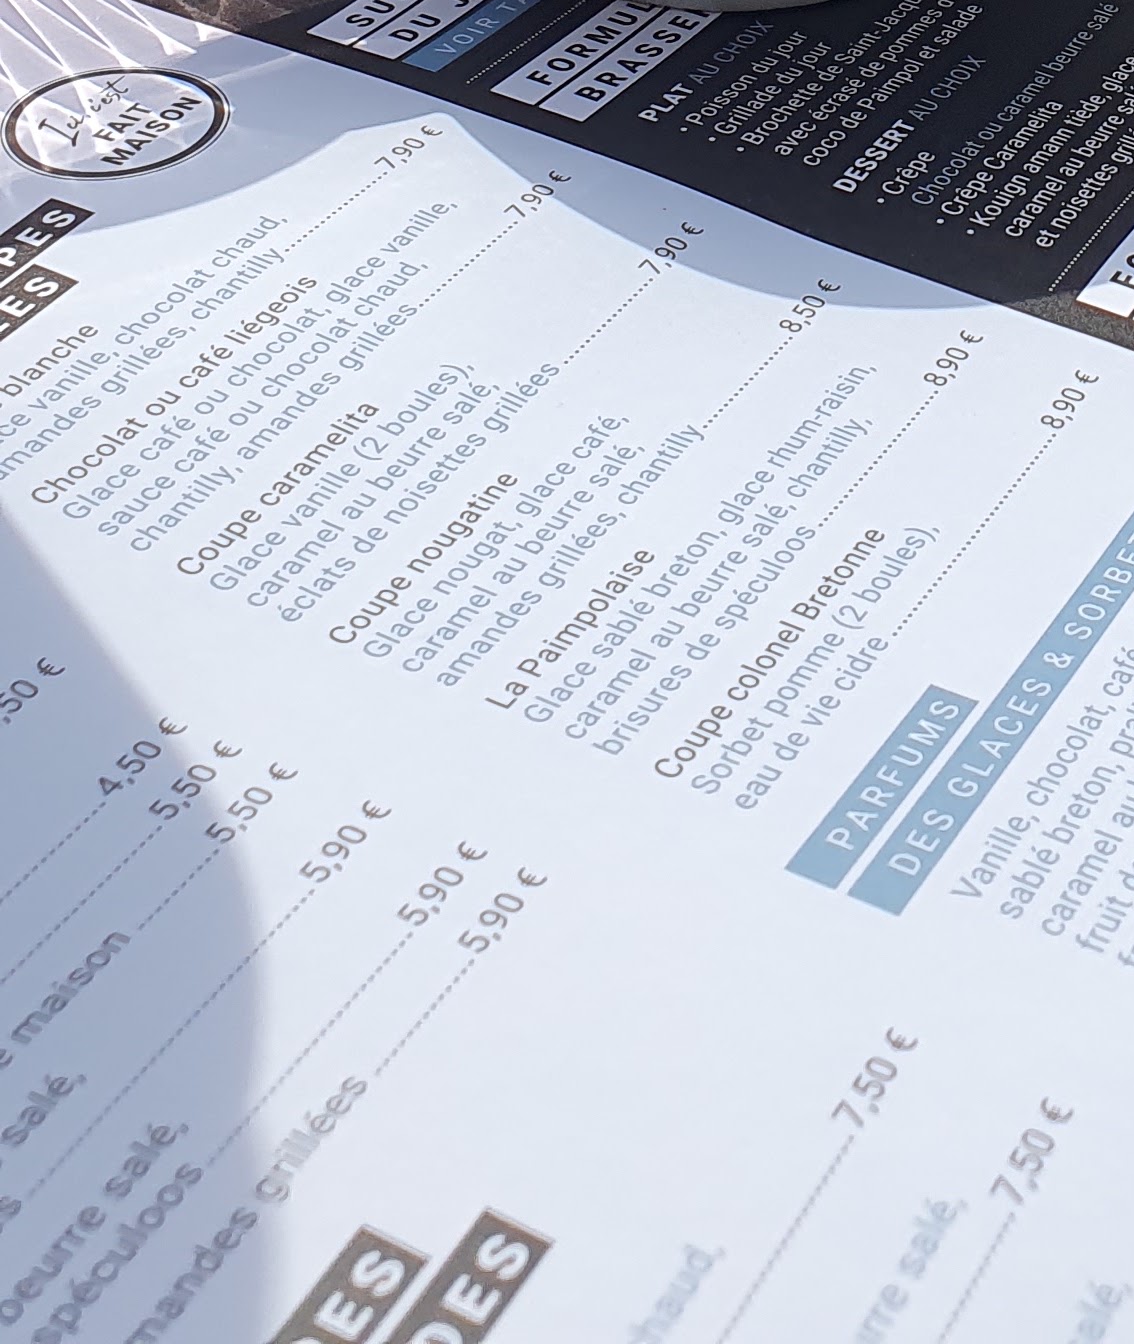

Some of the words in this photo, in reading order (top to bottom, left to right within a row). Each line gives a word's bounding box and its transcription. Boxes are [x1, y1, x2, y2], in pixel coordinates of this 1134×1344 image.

[387, 12, 441, 42] DU
[433, 17, 500, 53] VOIR
[637, 82, 693, 122] PLAT
[688, 62, 720, 84] AU
[712, 19, 774, 62] CHOIX
[92, 102, 154, 143] FAIT
[99, 96, 204, 167] MAISON
[373, 137, 425, 169] 7,90
[420, 124, 443, 136] €
[740, 82, 823, 145] Brochette
[816, 64, 843, 81] de
[832, 118, 914, 192] DESSERT
[907, 97, 938, 121] AU
[929, 54, 986, 98] CHOIX
[503, 183, 554, 217] 7,90
[548, 169, 572, 182] €
[940, 171, 993, 215] Crêpe
[982, 101, 1063, 169] Caramelita
[778, 294, 825, 333] 8,50
[816, 278, 841, 292] €
[30, 417, 148, 504] Chocolat
[144, 390, 181, 416] ou
[178, 344, 233, 388] café
[222, 276, 317, 345] liégeois
[922, 346, 969, 386] 8,90
[958, 329, 984, 344] €
[1039, 387, 1085, 429] 8,90
[1074, 369, 1099, 384] €
[176, 509, 262, 575] Coupe
[259, 403, 379, 506] caramelita
[328, 576, 412, 644] Coupe
[406, 473, 518, 573] nougatine
[484, 681, 529, 709] La
[516, 550, 655, 678] Paimpolaise
[653, 704, 733, 778] Coupe
[726, 619, 805, 701] colonel
[790, 529, 885, 620] Bretonne
[98, 740, 161, 806] 4,50
[825, 700, 959, 850] PARFUMS
[887, 808, 954, 876] DES
[947, 678, 1051, 797] GLACES
[1042, 651, 1074, 668] &
[949, 814, 1040, 898] Vanille,
[1025, 704, 1116, 806] chocolat,
